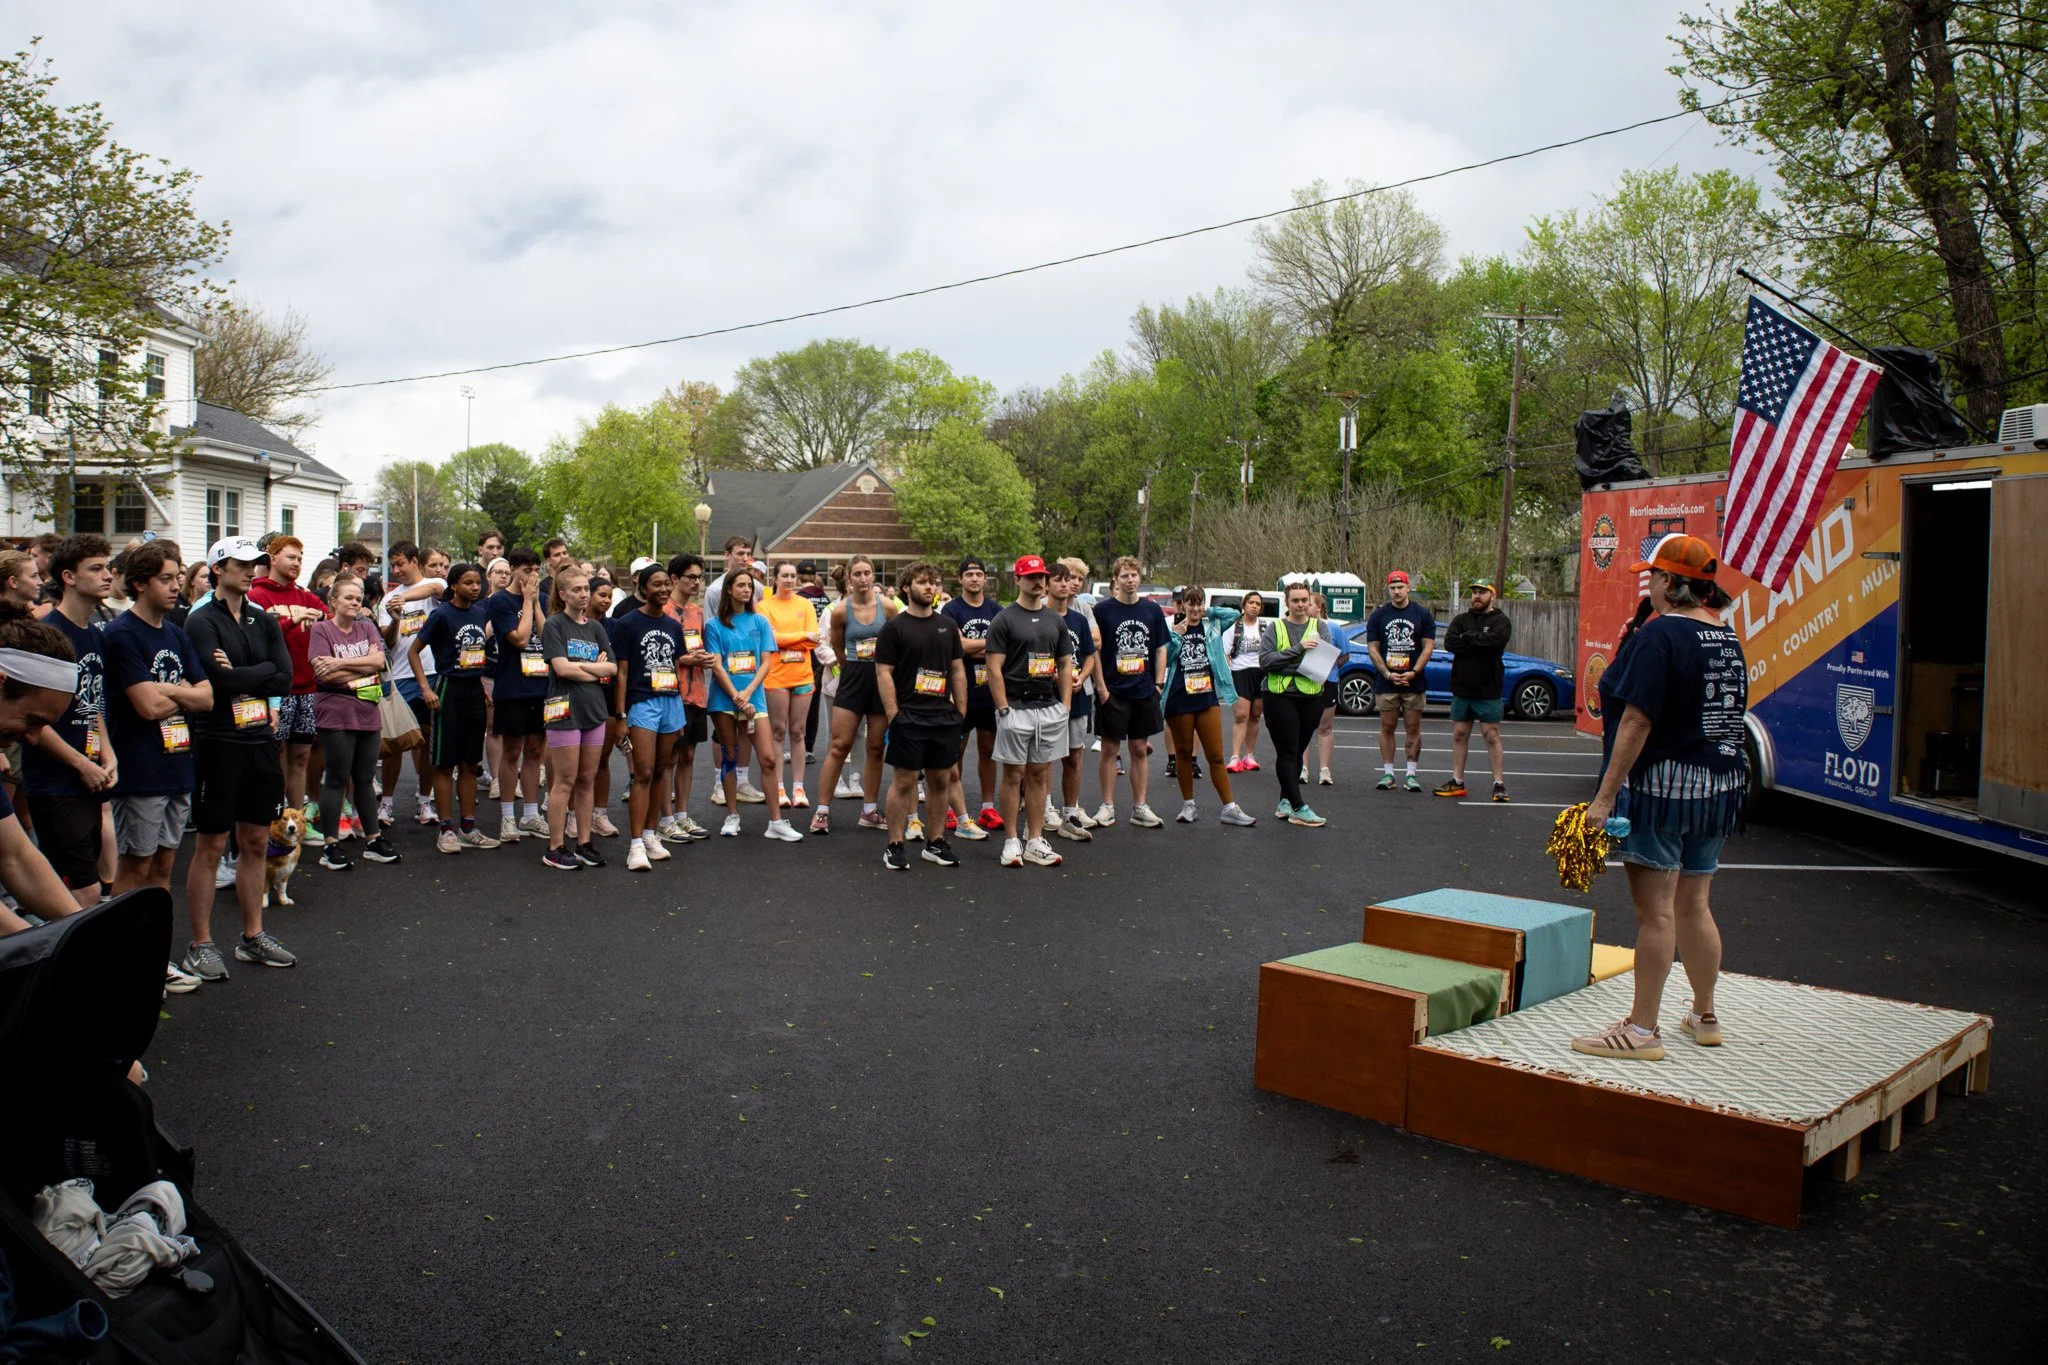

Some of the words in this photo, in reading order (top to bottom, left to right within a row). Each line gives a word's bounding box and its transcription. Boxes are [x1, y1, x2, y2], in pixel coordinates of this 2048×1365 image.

[1629, 503, 1705, 517] HeartlandRacingCo.com
[1115, 619, 1134, 635] POTTER'S
[1136, 621, 1150, 634] HOUSE
[1696, 630, 1726, 640] VERSE
[1783, 600, 1840, 656] COUNTRY
[1720, 648, 1737, 657] ASEA
[77, 652, 96, 673] OTTER'S
[1826, 663, 1846, 674] Proudly
[1876, 669, 1889, 679] With
[1824, 751, 1880, 787] FLOYD
[1825, 778, 1854, 792] FINANCIAL
[1855, 786, 1877, 798] GROUP
